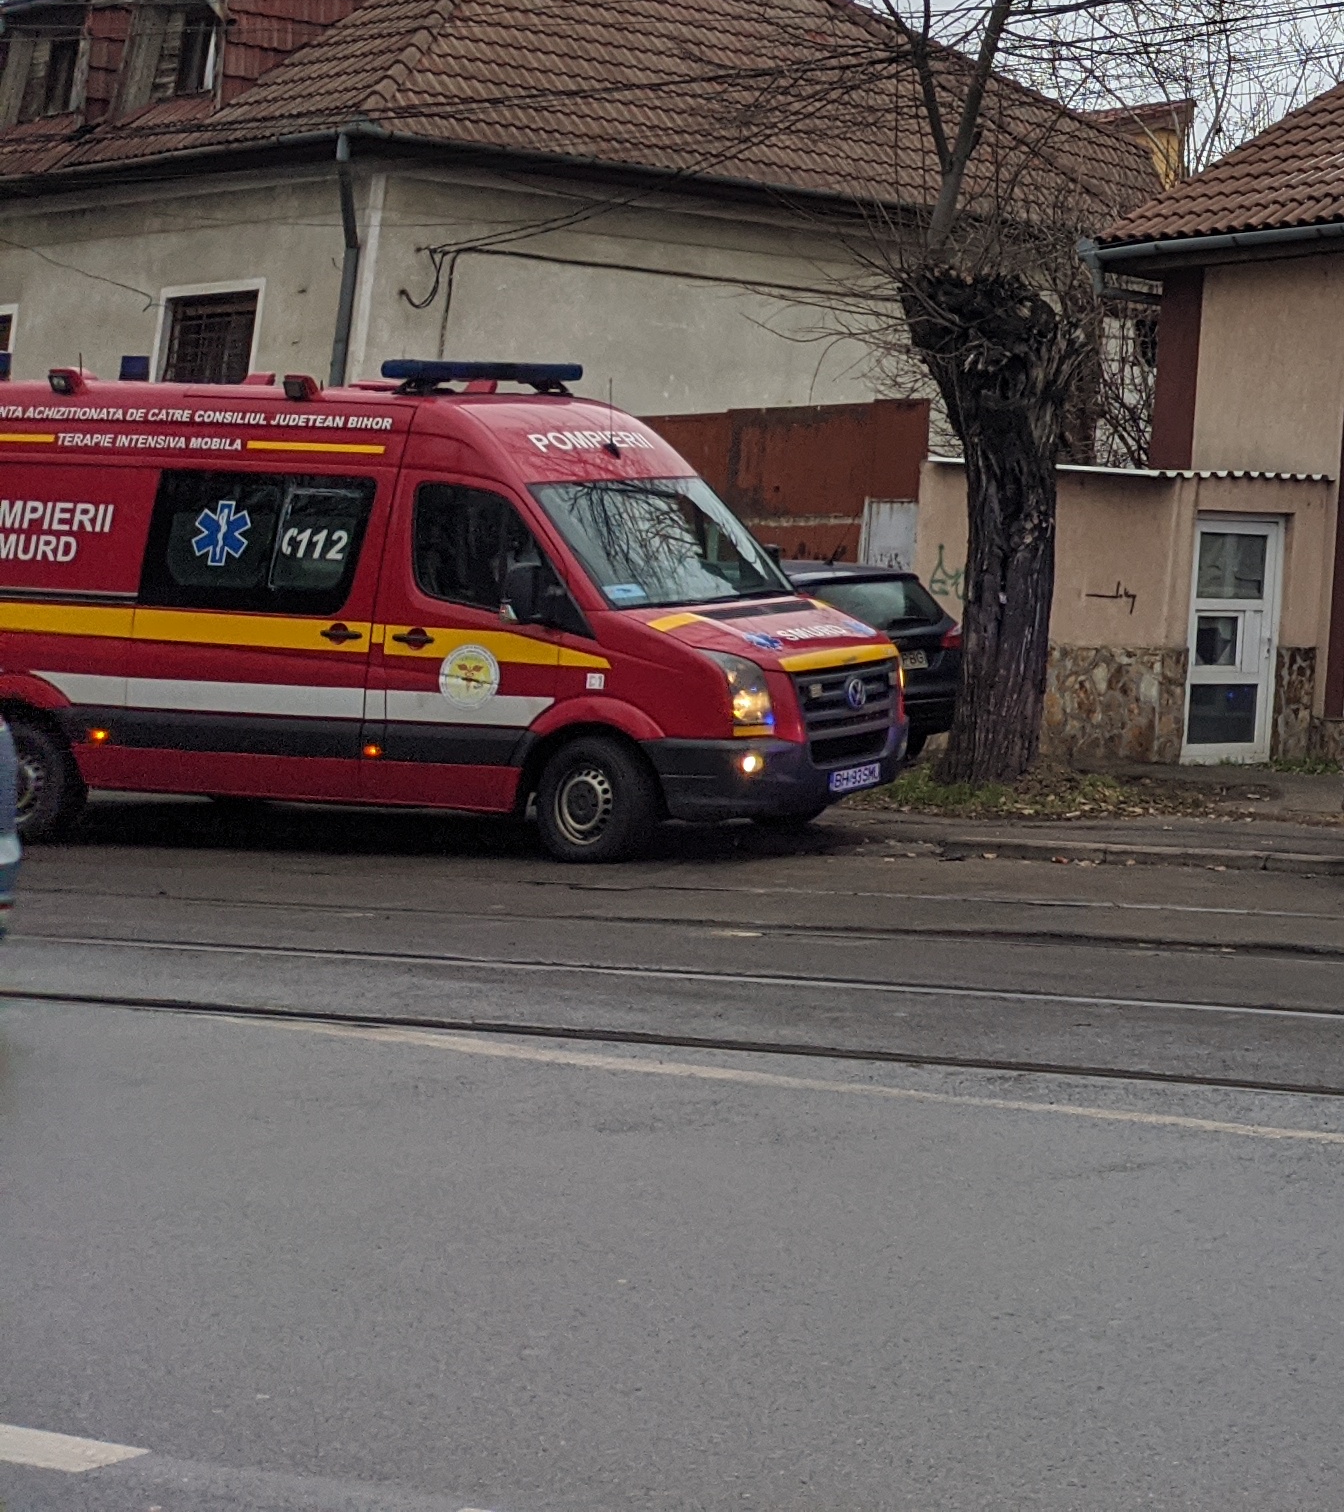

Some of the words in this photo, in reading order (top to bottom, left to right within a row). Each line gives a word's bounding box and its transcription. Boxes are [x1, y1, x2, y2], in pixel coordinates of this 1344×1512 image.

[25, 406, 123, 421] ACHIZITIONATA
[126, 408, 145, 421] DE
[149, 409, 192, 422] CATRE
[194, 410, 267, 425] CONSILIUL
[271, 413, 344, 428] JUDETEAN
[347, 416, 393, 430] BIHOR
[57, 433, 114, 447] TERAPIE
[116, 434, 186, 449] INTENSIVA
[189, 438, 242, 451] MOBILA
[526, 430, 655, 453] POMPIERII
[776, 624, 848, 641] SMURD
